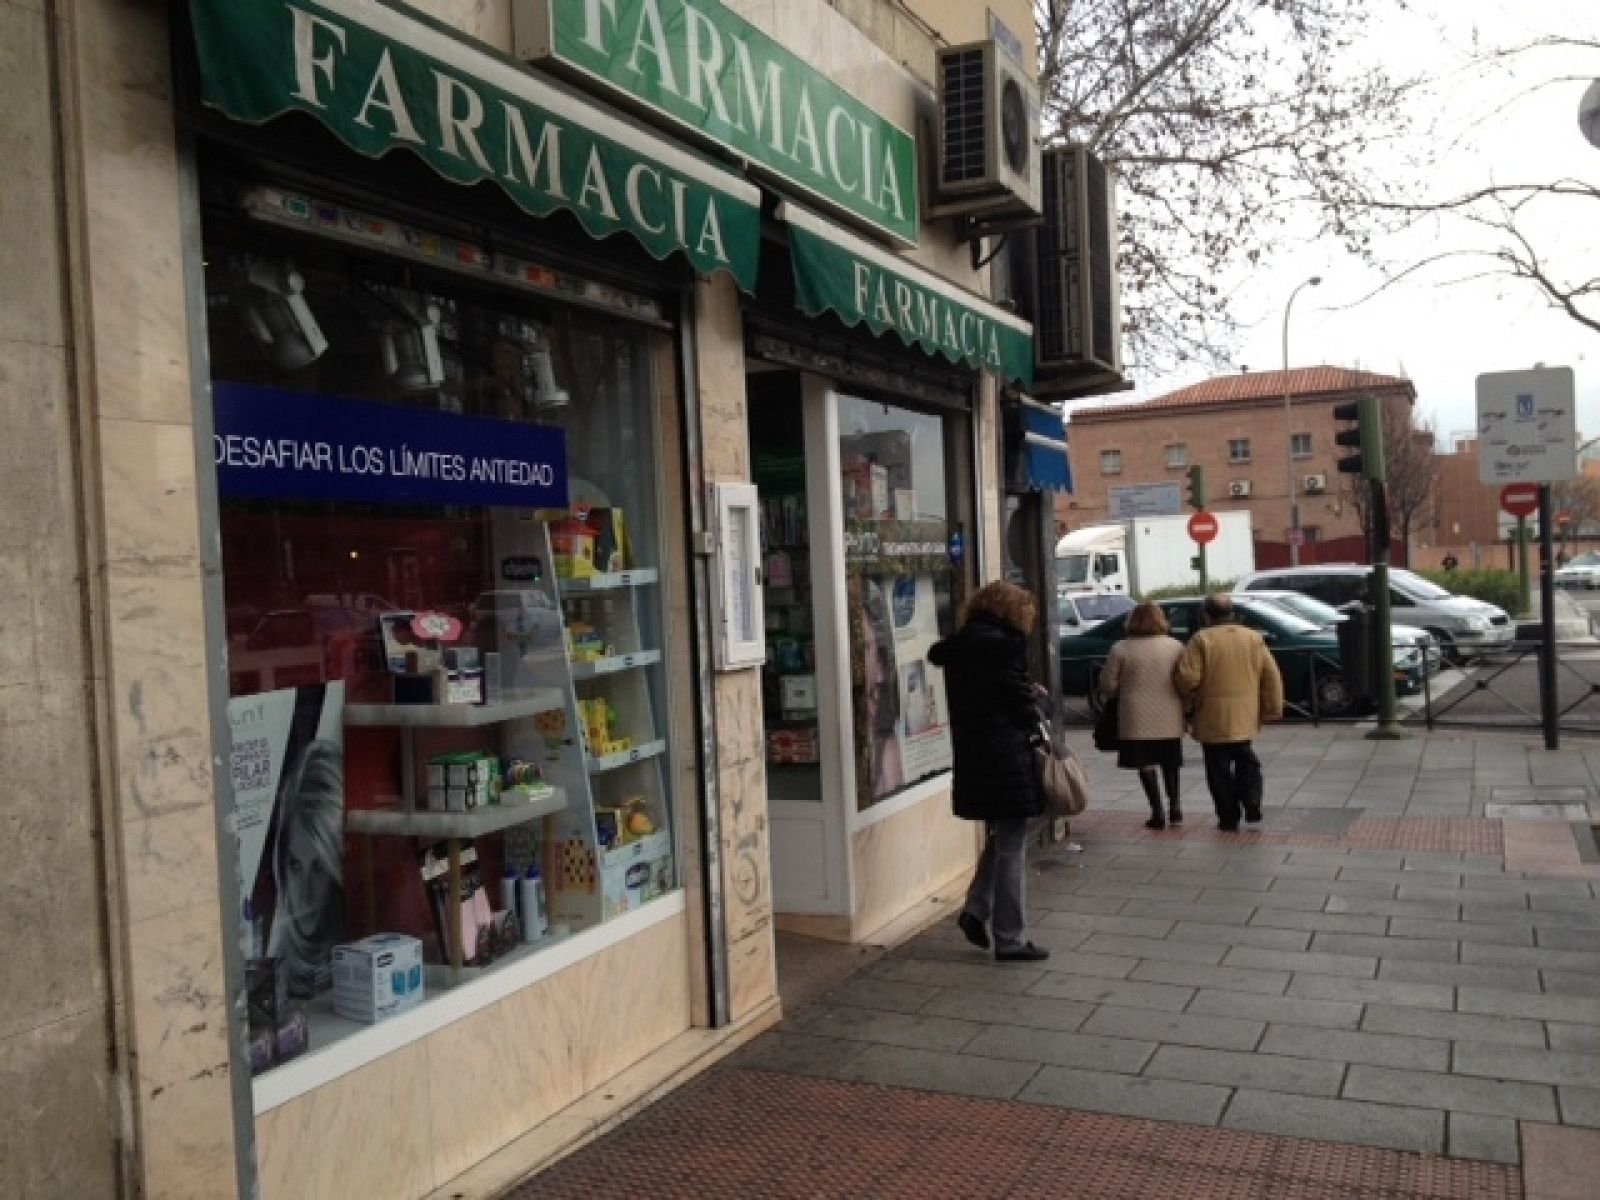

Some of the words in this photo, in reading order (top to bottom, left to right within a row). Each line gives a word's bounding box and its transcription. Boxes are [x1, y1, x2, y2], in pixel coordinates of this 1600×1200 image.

[286, 3, 730, 264] FARMACIA
[852, 259, 1001, 366] FARMACIA
[213, 434, 333, 471] DESAFIAR
[337, 444, 385, 475] LOS
[389, 443, 466, 481] LÍMITES
[469, 456, 554, 487] ANTIEDAD
